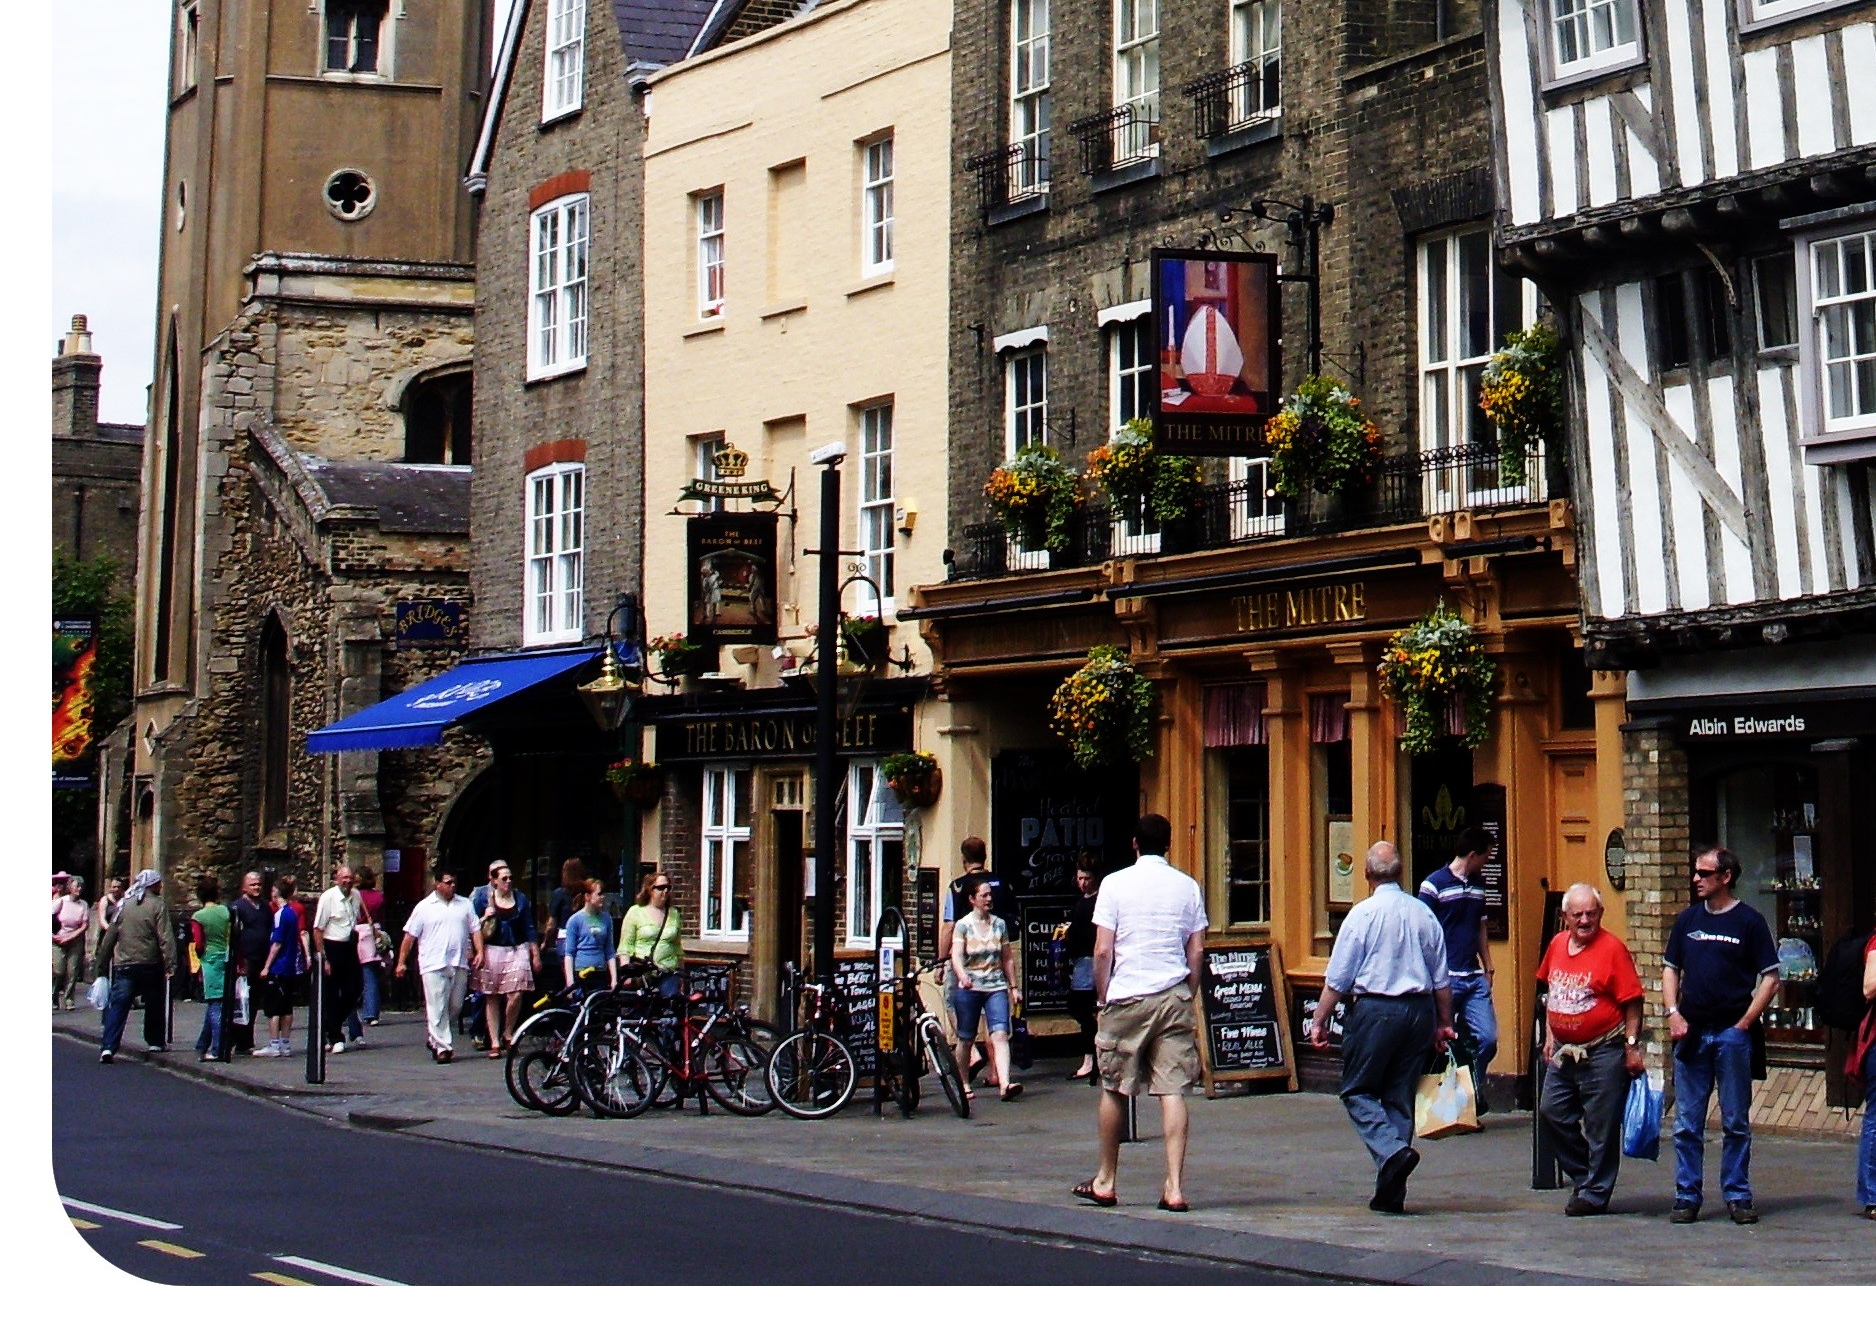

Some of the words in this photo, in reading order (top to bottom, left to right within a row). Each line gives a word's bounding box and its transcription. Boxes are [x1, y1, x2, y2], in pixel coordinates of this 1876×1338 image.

[1164, 424, 1202, 440] THE
[695, 482, 740, 495] GREENE
[742, 482, 768, 494] KING
[1231, 592, 1279, 631] THE
[1286, 581, 1367, 627] MITRE
[685, 722, 717, 753] THE
[724, 719, 795, 752] BARON
[836, 715, 877, 747] EEF
[1689, 718, 1727, 735] Albin
[1734, 715, 1805, 734] Edwards
[1021, 817, 1105, 847] PATIO
